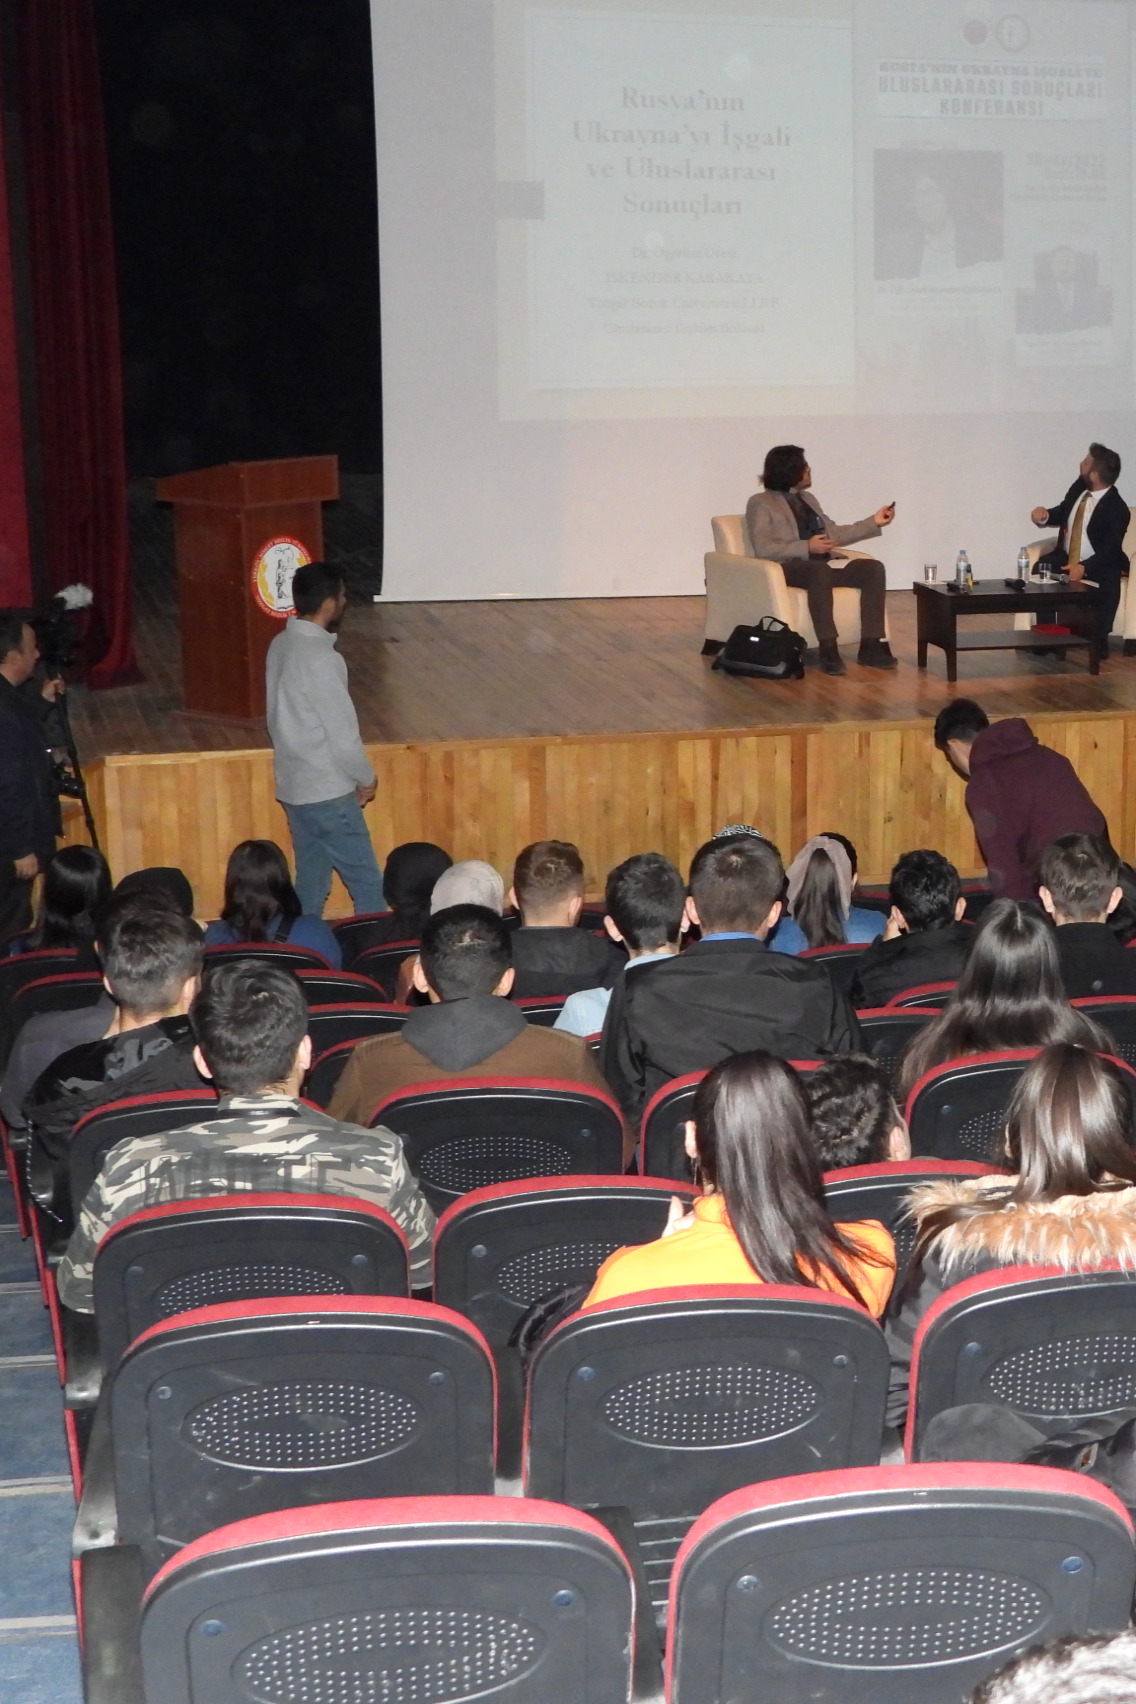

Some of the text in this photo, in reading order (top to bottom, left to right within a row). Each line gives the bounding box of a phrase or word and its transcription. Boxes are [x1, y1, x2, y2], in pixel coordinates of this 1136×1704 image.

[878, 75, 1103, 100] ULUSLARARASI SONUÇLARI
[940, 98, 1044, 116] KONFERANSI
[722, 119, 792, 152] İşgali
[586, 156, 776, 181] ve Uluslararası
[623, 192, 743, 219] Sonuçları
